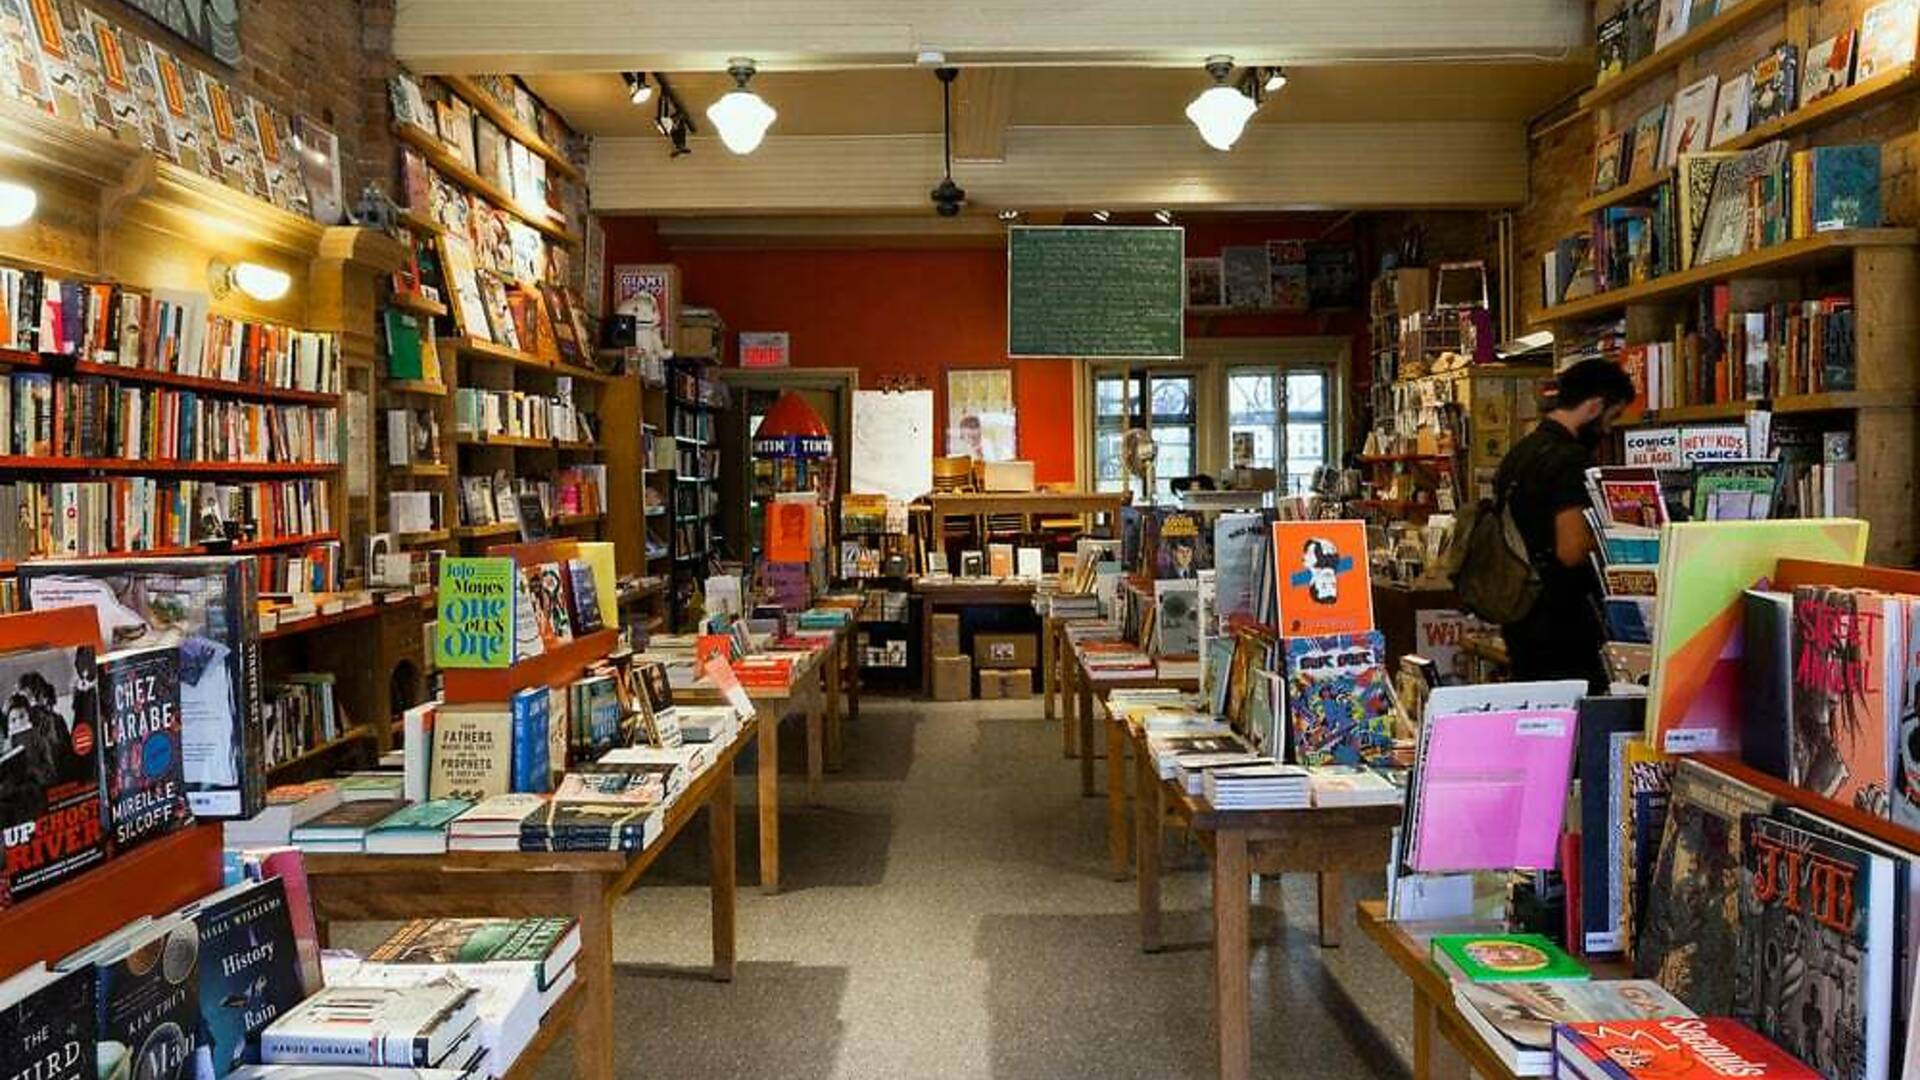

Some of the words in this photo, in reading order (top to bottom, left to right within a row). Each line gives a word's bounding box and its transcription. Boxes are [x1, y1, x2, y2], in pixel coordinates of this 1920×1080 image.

[1627, 436, 1676, 448] COMICS
[1685, 450, 1742, 460] COMICS
[1715, 434, 1744, 449] KIDS
[446, 562, 475, 579] Jojo
[454, 579, 504, 596] Moyes
[114, 676, 156, 711] CHEZ
[103, 702, 172, 747] L'ARABE
[443, 730, 493, 743] FATHERS
[441, 759, 493, 769] PROPHETS
[112, 782, 176, 823] MIREILLE
[3, 820, 36, 848] UP
[117, 804, 173, 844] SILCOFF
[4, 819, 101, 873] RIVER
[221, 942, 275, 977] History
[244, 1003, 278, 1031] Rain
[22, 1024, 51, 1052] THE
[1659, 1020, 1768, 1077] Seconds
